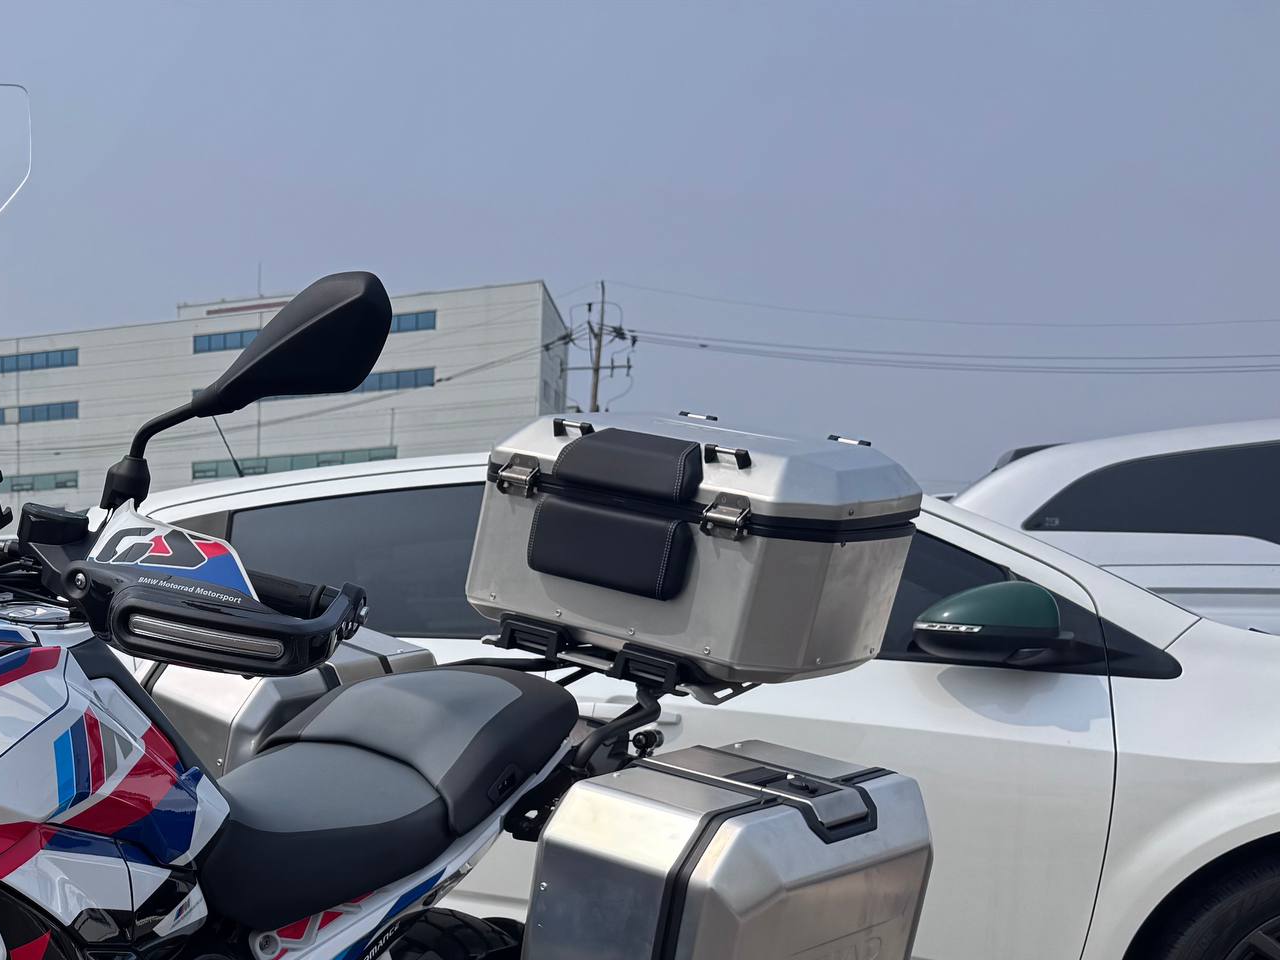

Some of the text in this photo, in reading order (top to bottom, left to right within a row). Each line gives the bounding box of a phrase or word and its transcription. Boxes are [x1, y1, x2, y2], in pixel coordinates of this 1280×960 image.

[137, 575, 242, 604] BMW Motorrad Motorsport
